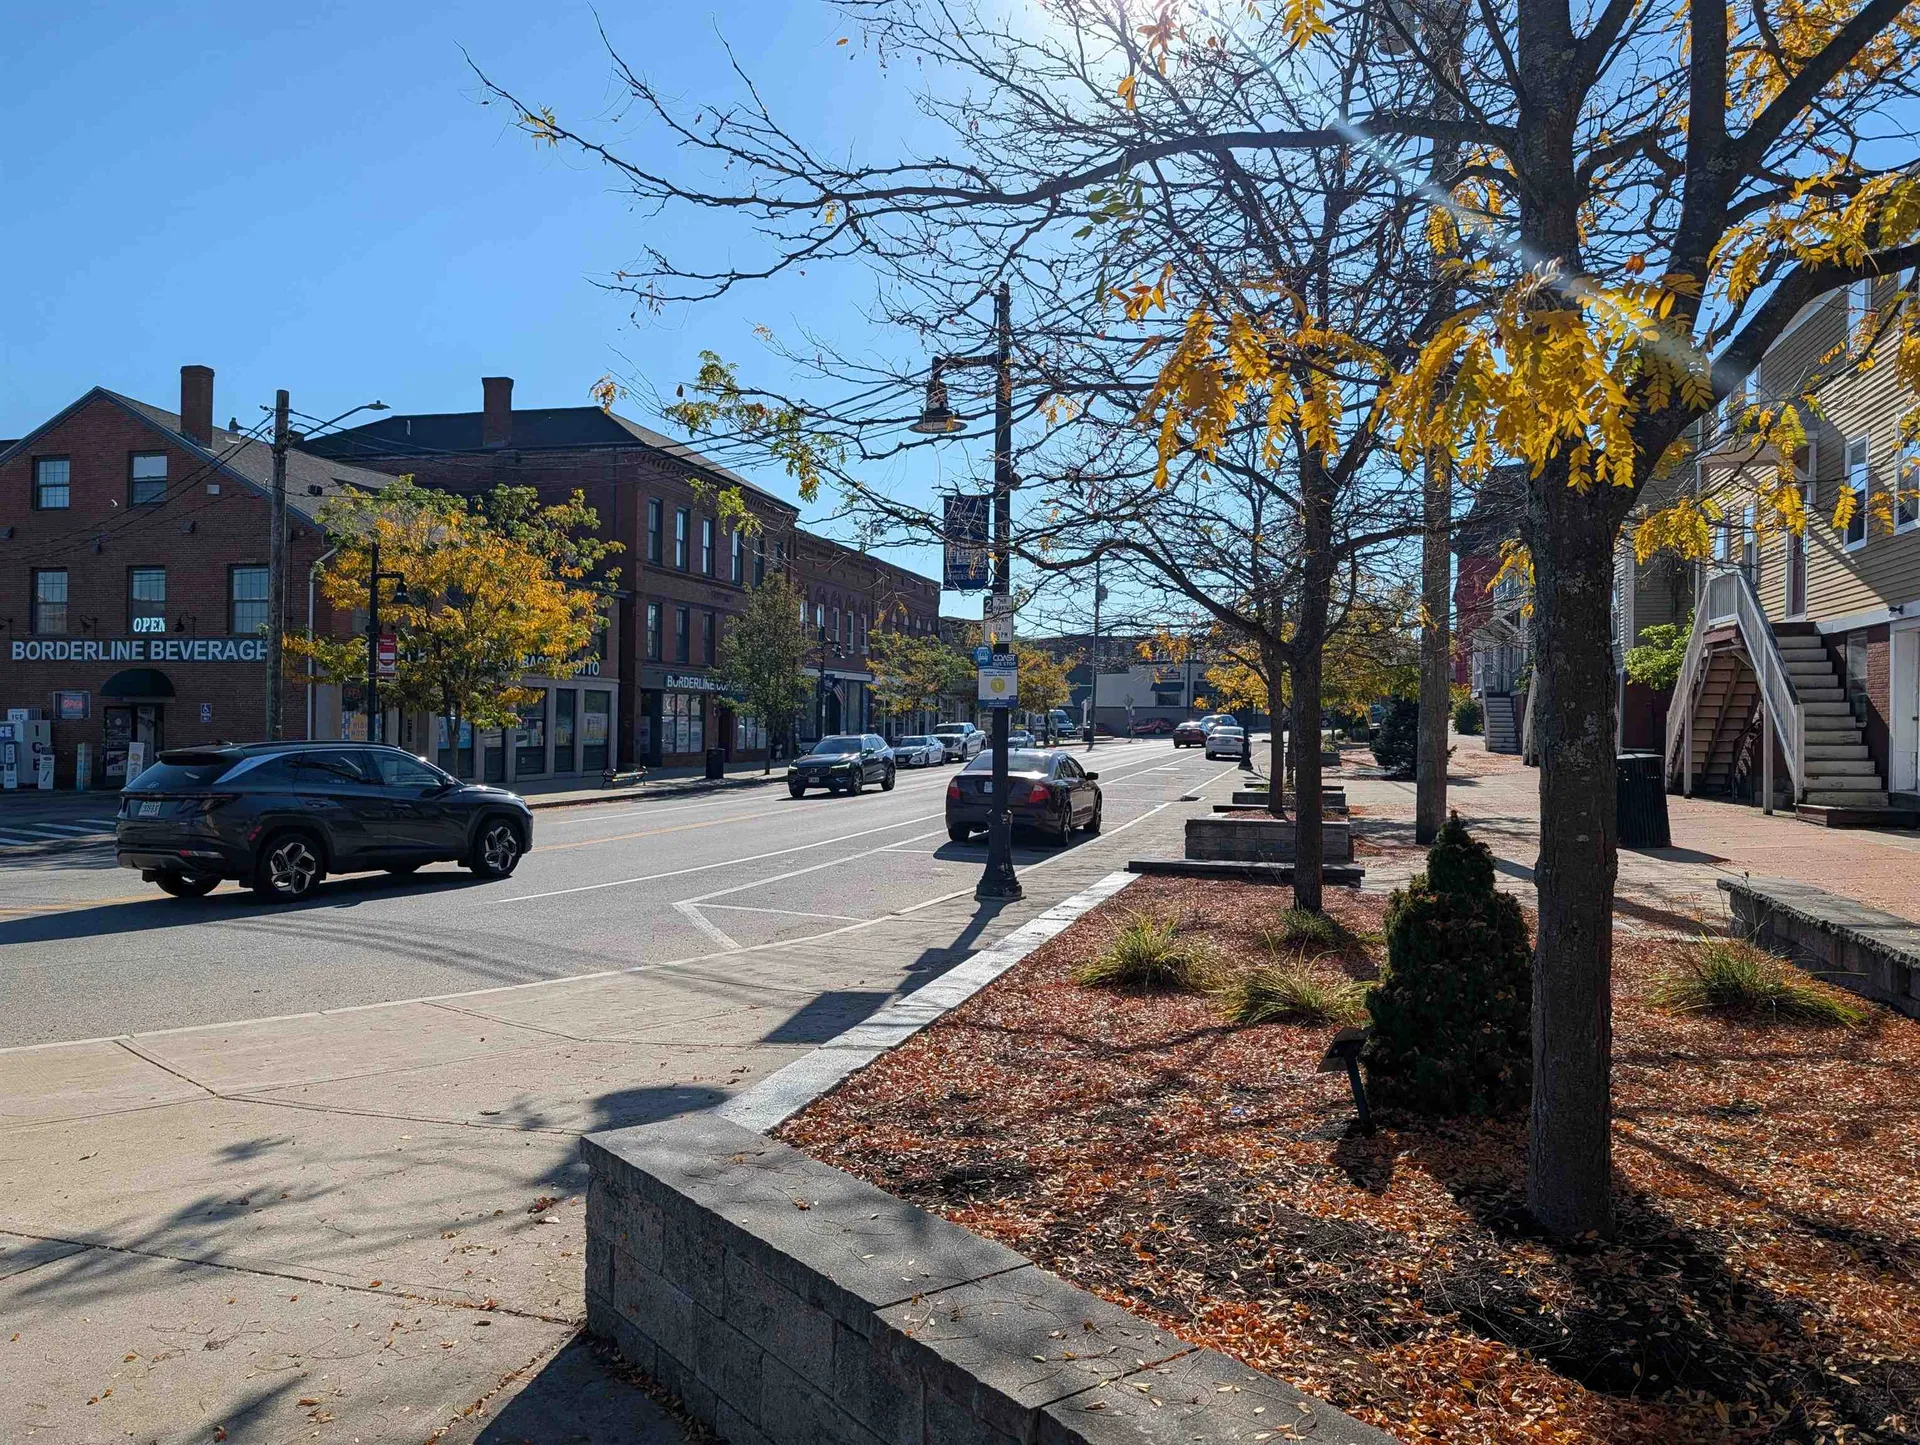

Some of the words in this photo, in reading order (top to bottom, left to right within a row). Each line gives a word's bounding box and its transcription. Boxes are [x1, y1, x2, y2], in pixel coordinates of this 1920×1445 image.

[985, 599, 992, 611] 2
[133, 617, 166, 632] OPEN
[11, 640, 145, 660] BORDERLINE
